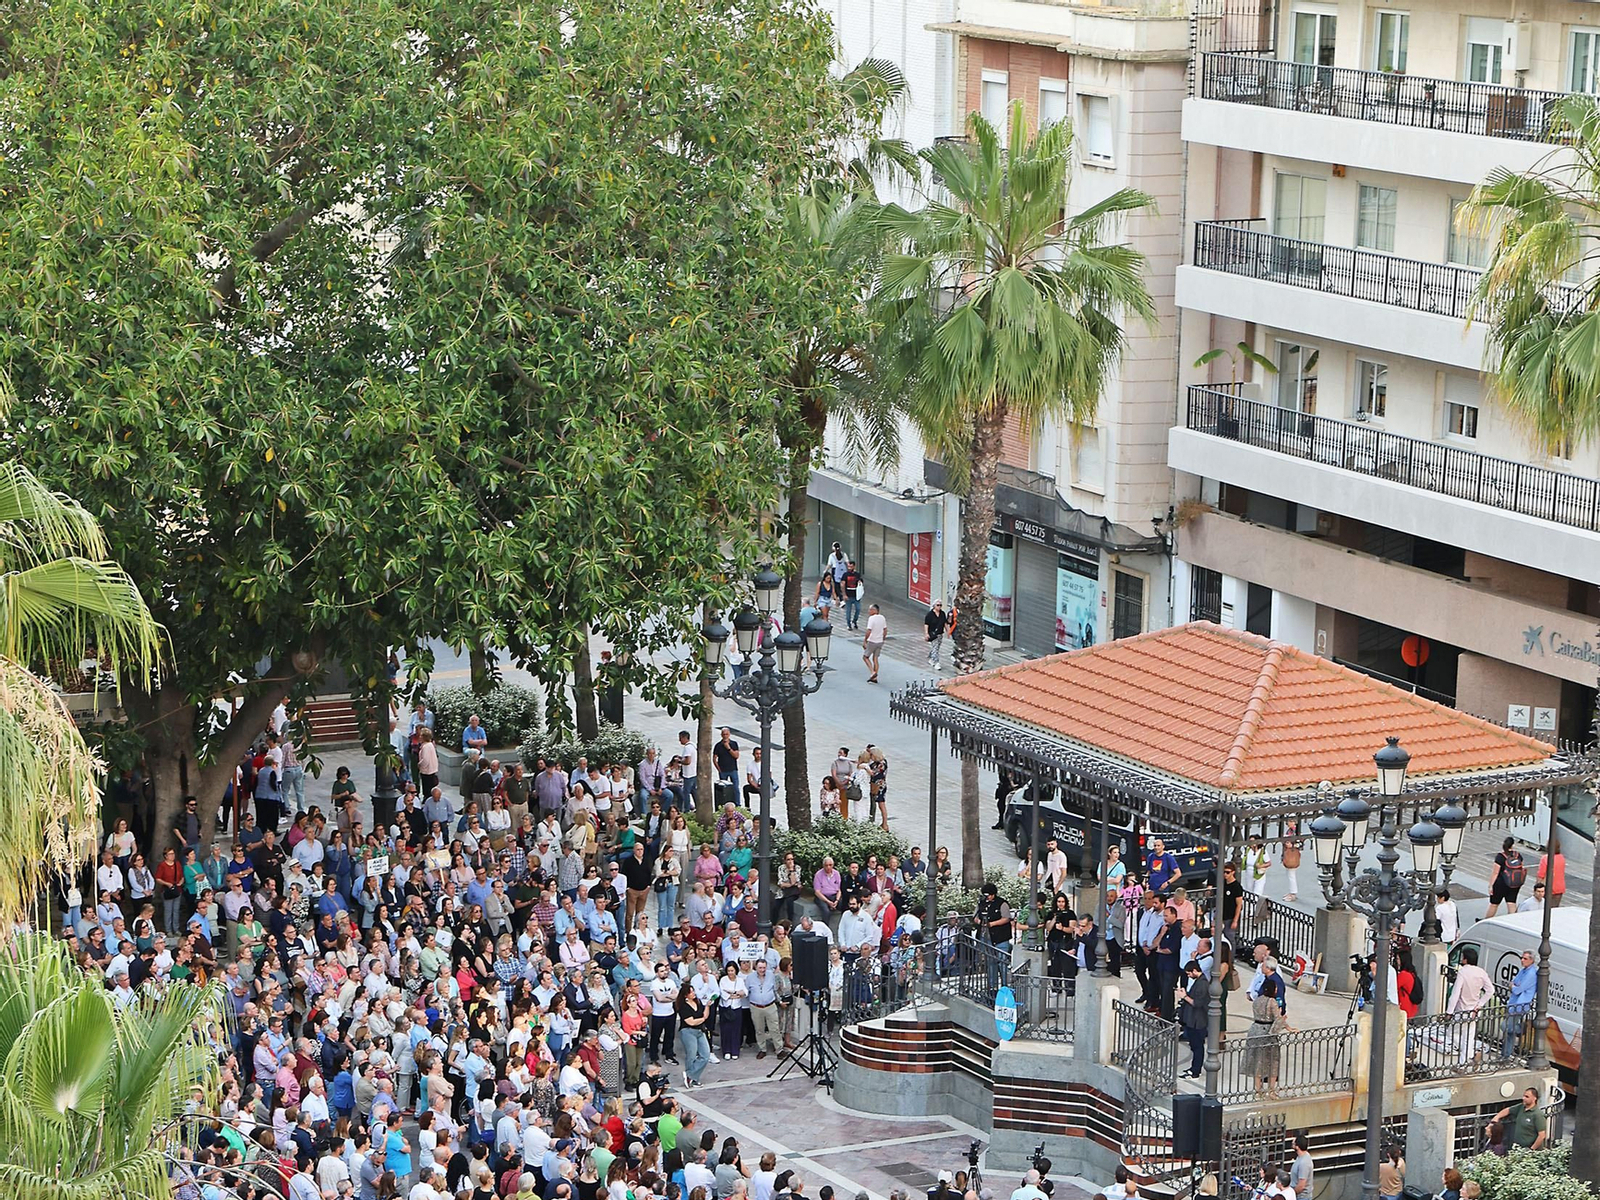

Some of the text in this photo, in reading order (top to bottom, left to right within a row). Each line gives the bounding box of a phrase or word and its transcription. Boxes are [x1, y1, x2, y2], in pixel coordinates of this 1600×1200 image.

[1014, 520, 1024, 531] 607
[1052, 821, 1084, 838] POLICIA
[1052, 830, 1085, 847] NACIONA
[1164, 846, 1199, 857] OLICIA
[1548, 980, 1564, 992] NIDO
[1547, 997, 1578, 1013] LTIMEDIA
[1548, 989, 1583, 1007] MINACIÓN
